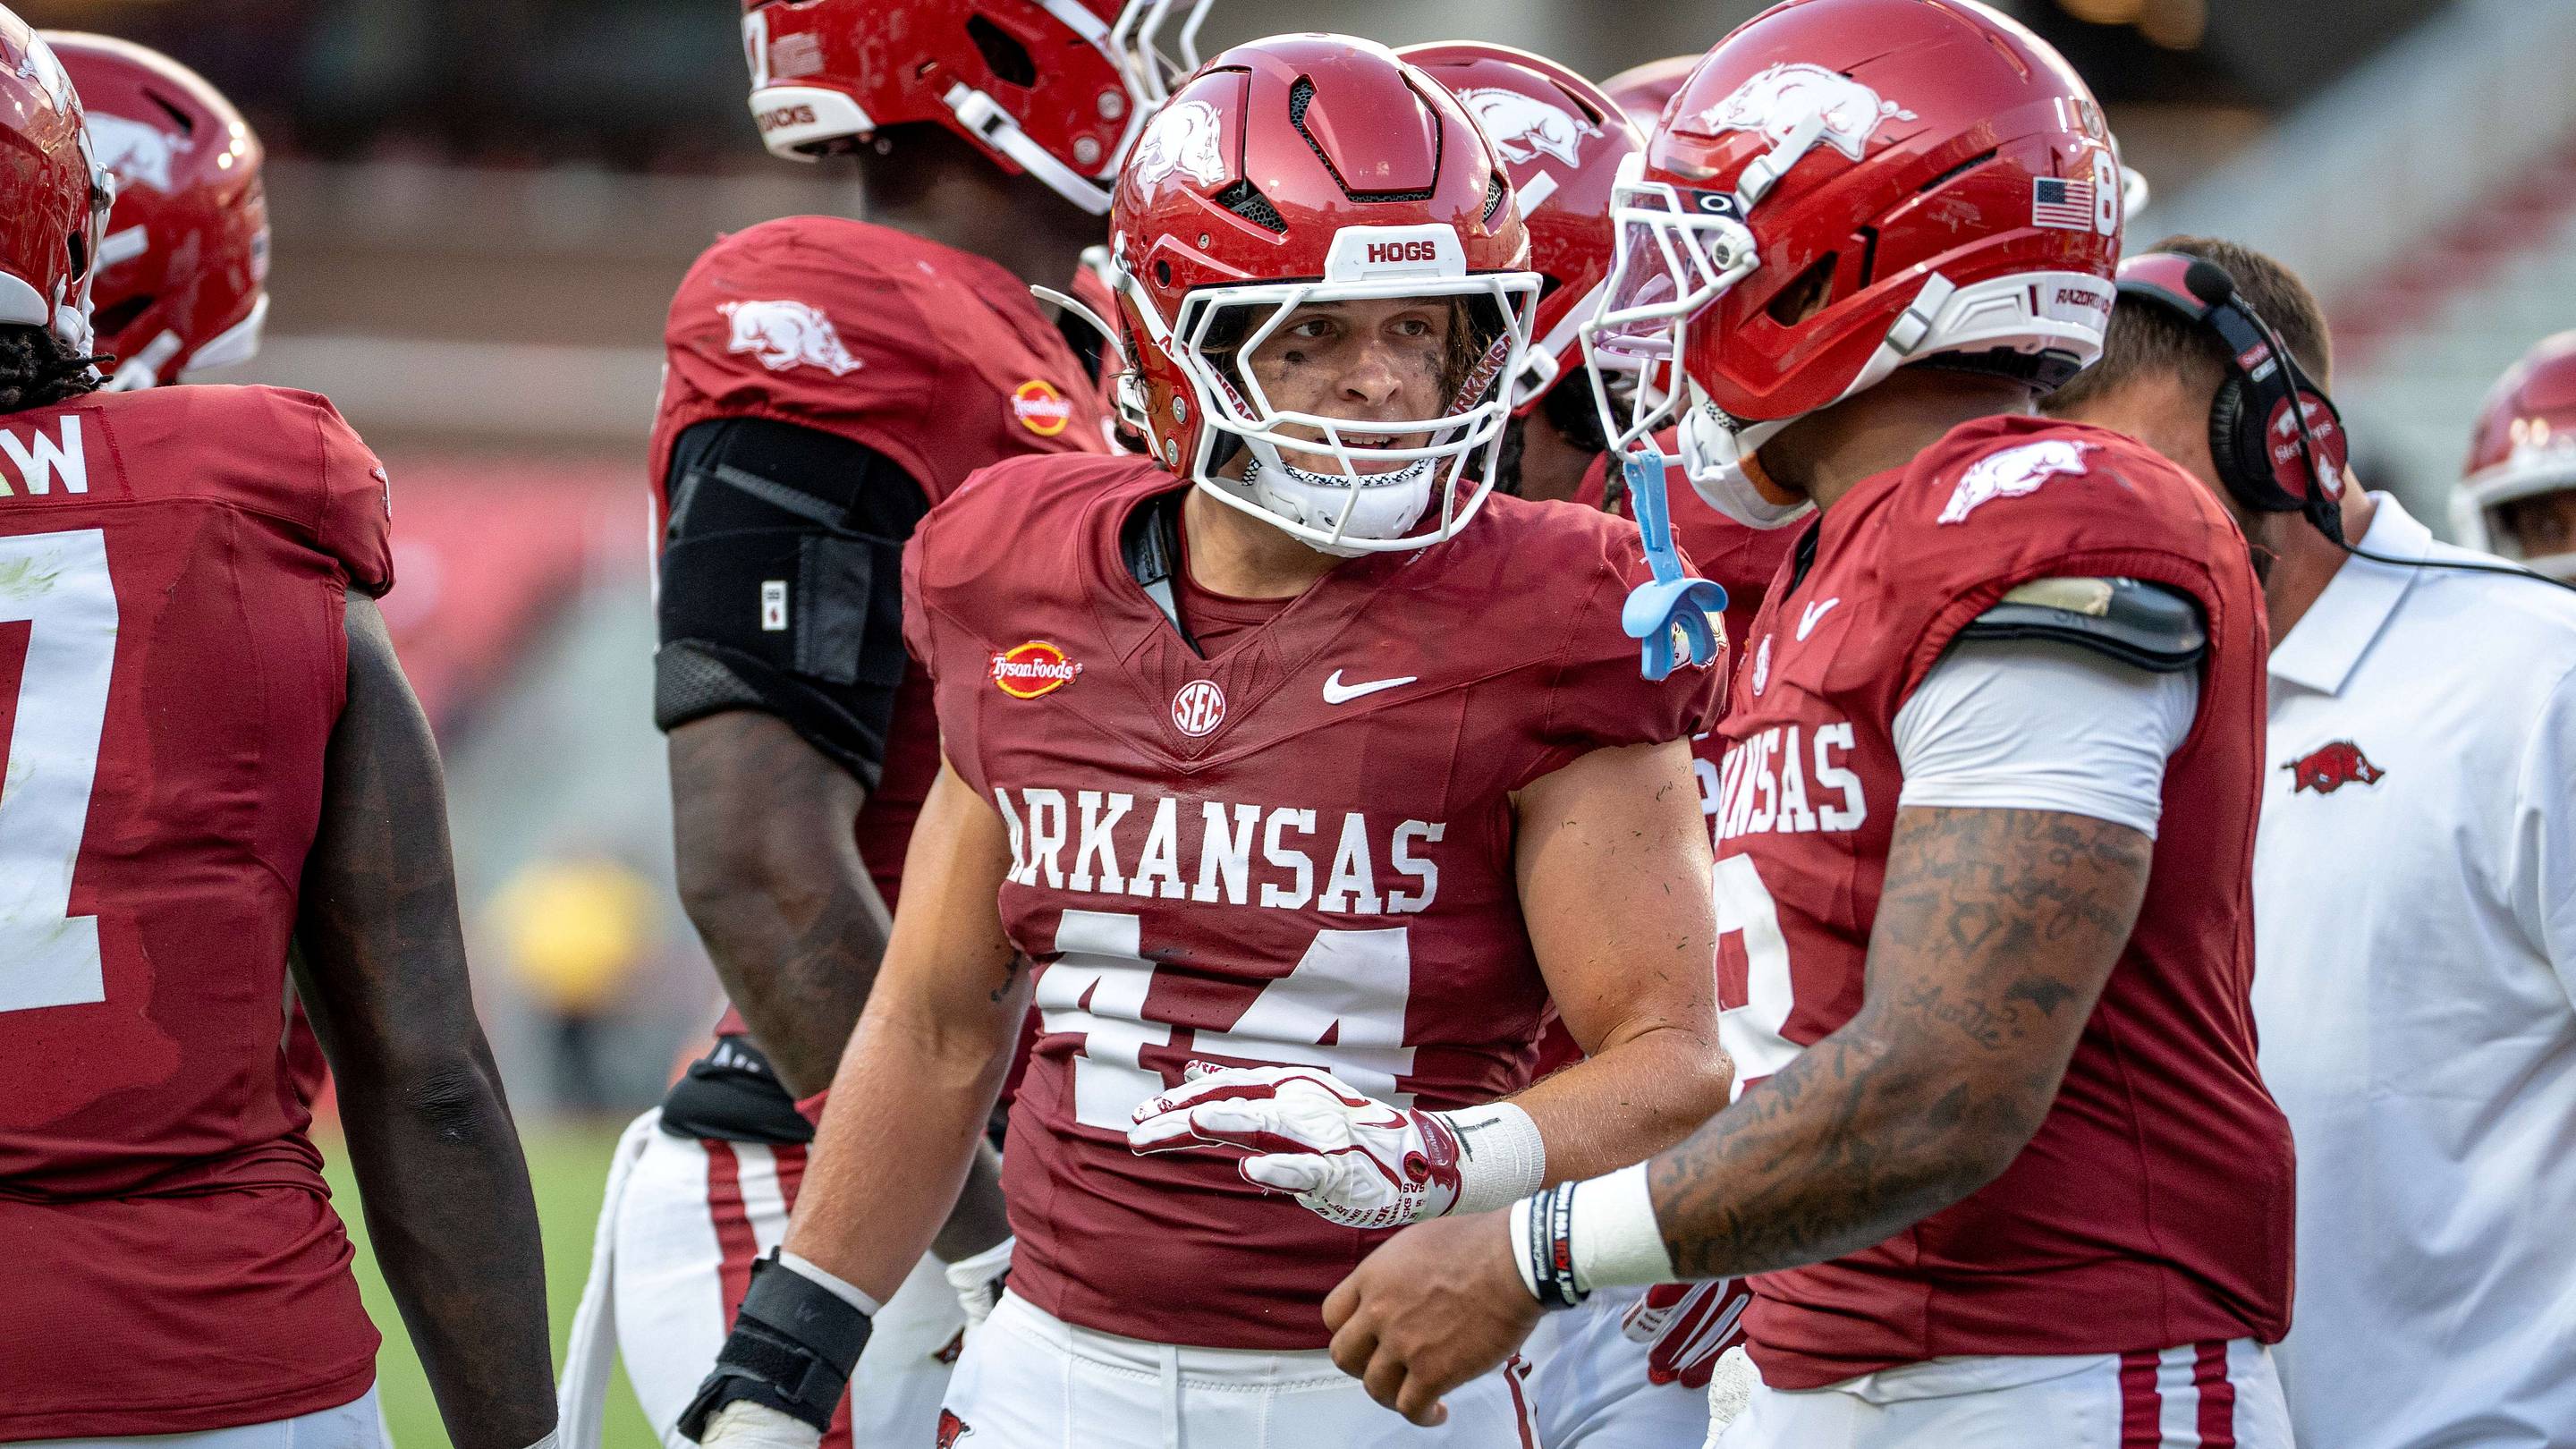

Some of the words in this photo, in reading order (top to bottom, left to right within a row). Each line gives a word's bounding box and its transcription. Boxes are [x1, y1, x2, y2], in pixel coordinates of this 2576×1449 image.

[2093, 149, 2119, 236] 8
[1367, 241, 1436, 263] HOGS
[1176, 683, 1222, 733] SEC
[994, 787, 1446, 915] ARKANSAS
[1035, 909, 1418, 1131] 44
